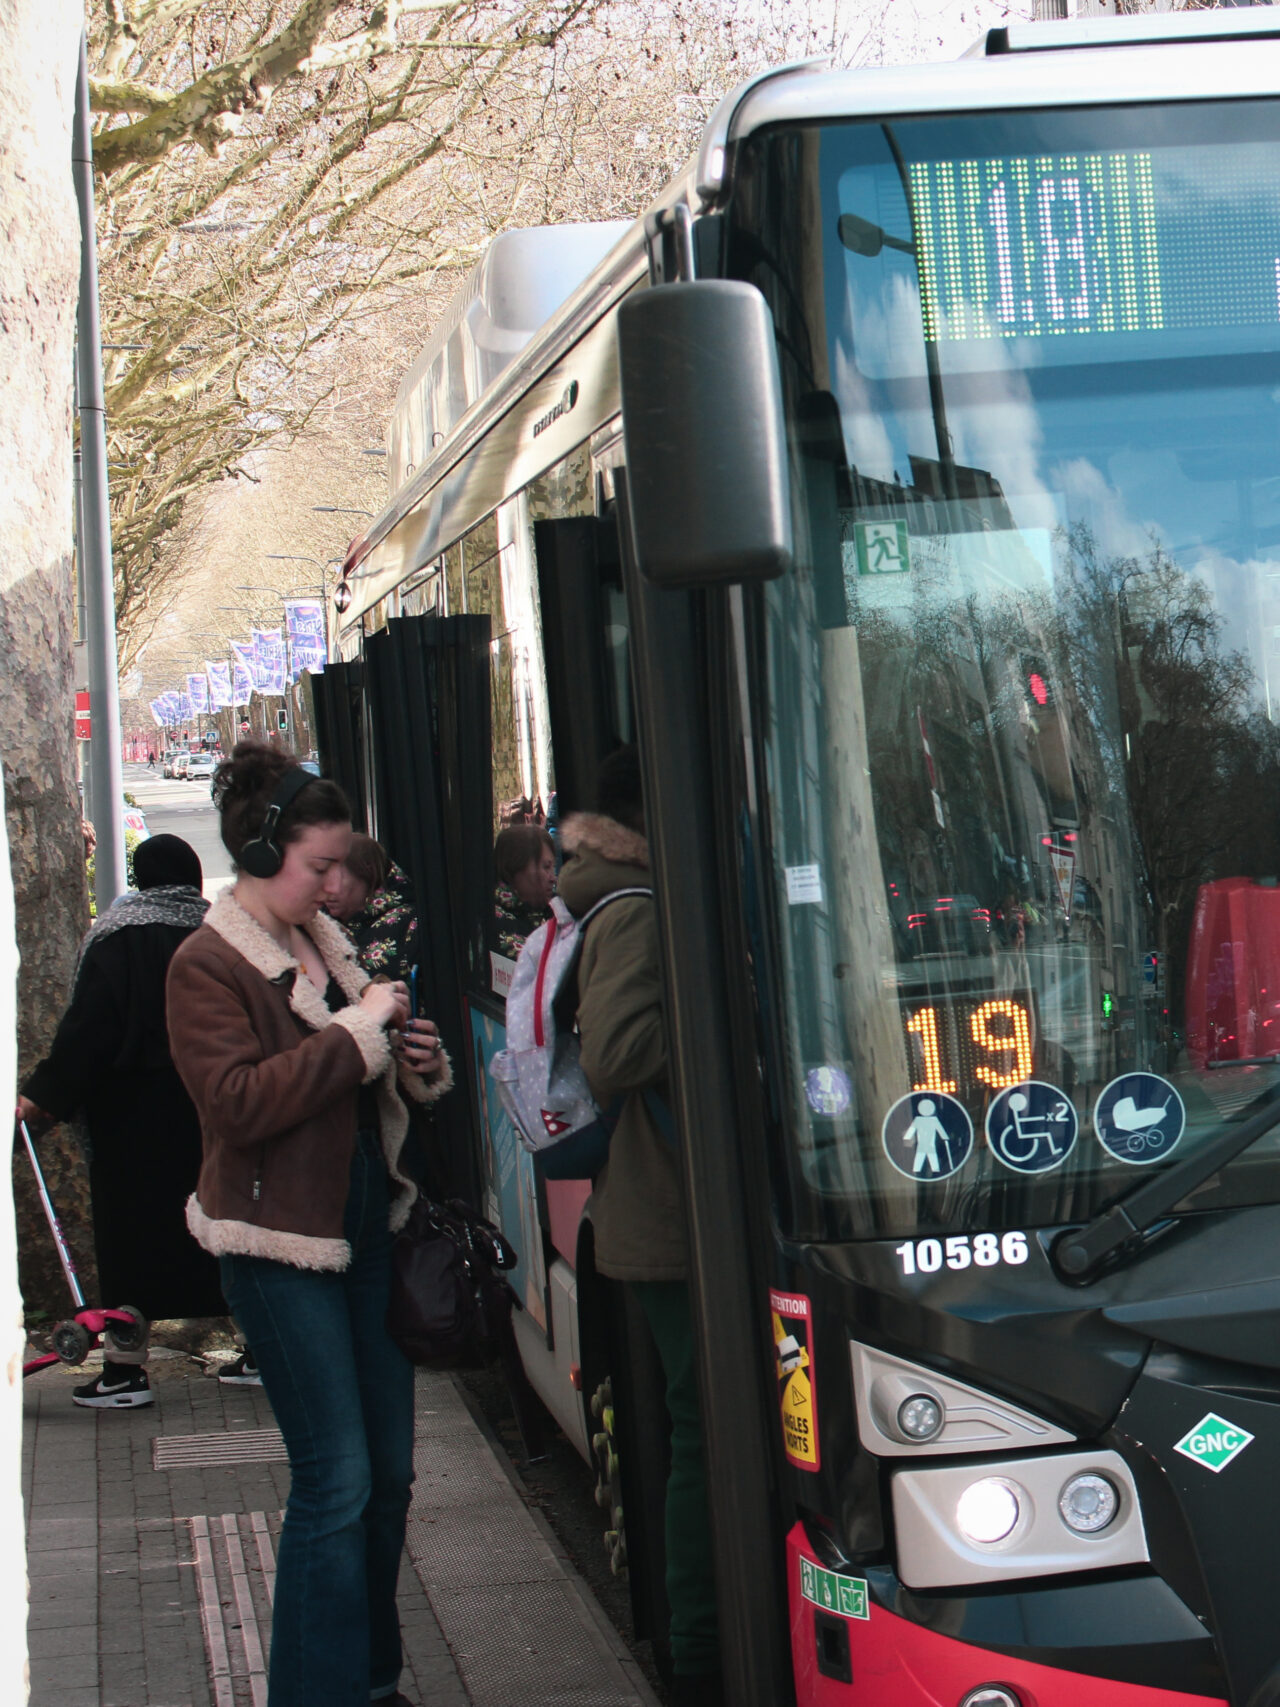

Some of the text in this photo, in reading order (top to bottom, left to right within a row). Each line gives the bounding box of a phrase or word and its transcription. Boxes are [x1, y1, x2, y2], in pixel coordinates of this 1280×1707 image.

[987, 177, 1099, 323] 18
[907, 999, 1033, 1094] 19
[1046, 1102, 1070, 1123] x2
[896, 1231, 1029, 1275] 10586
[1189, 1429, 1239, 1455] GNC
